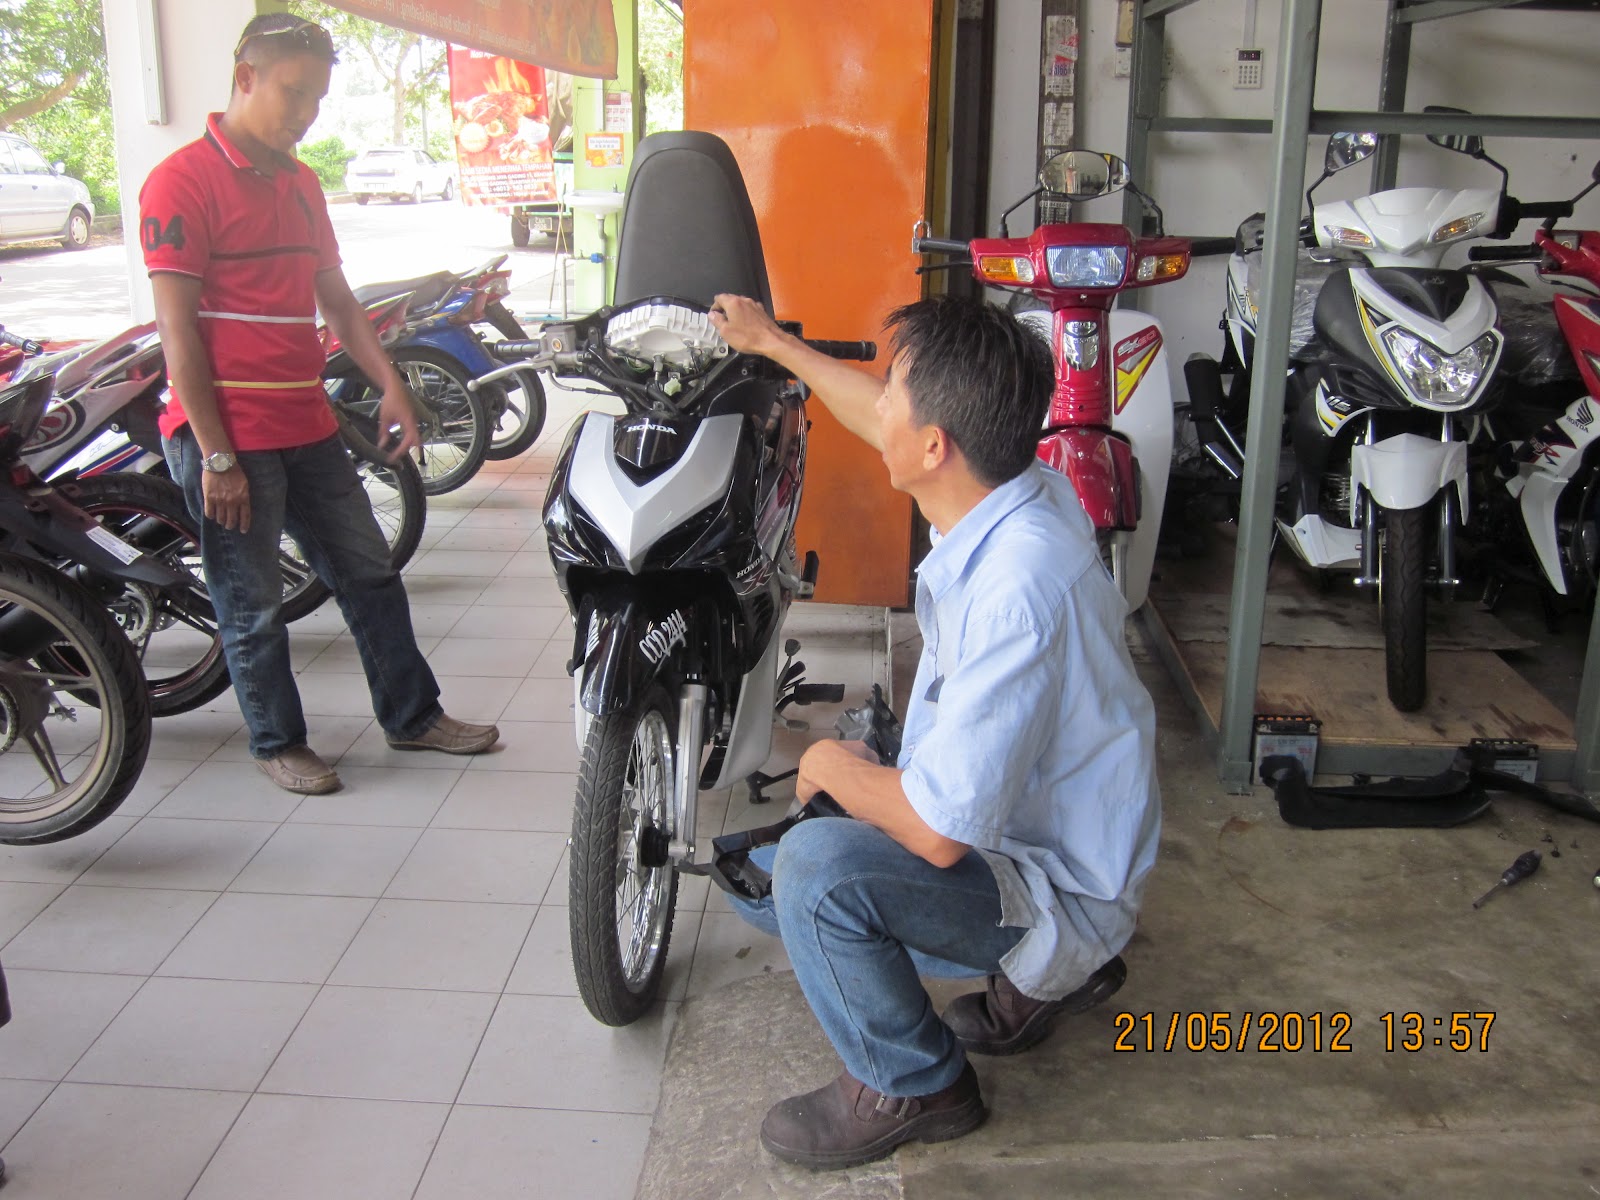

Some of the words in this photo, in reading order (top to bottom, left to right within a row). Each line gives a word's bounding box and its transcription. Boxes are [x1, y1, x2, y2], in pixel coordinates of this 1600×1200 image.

[492, 164, 521, 173] MENERIMA
[522, 163, 552, 171] TEMPAHAN
[144, 214, 186, 252] 04
[627, 424, 678, 435] HONDA
[1566, 415, 1590, 434] HONDA
[735, 553, 764, 579] HONDA
